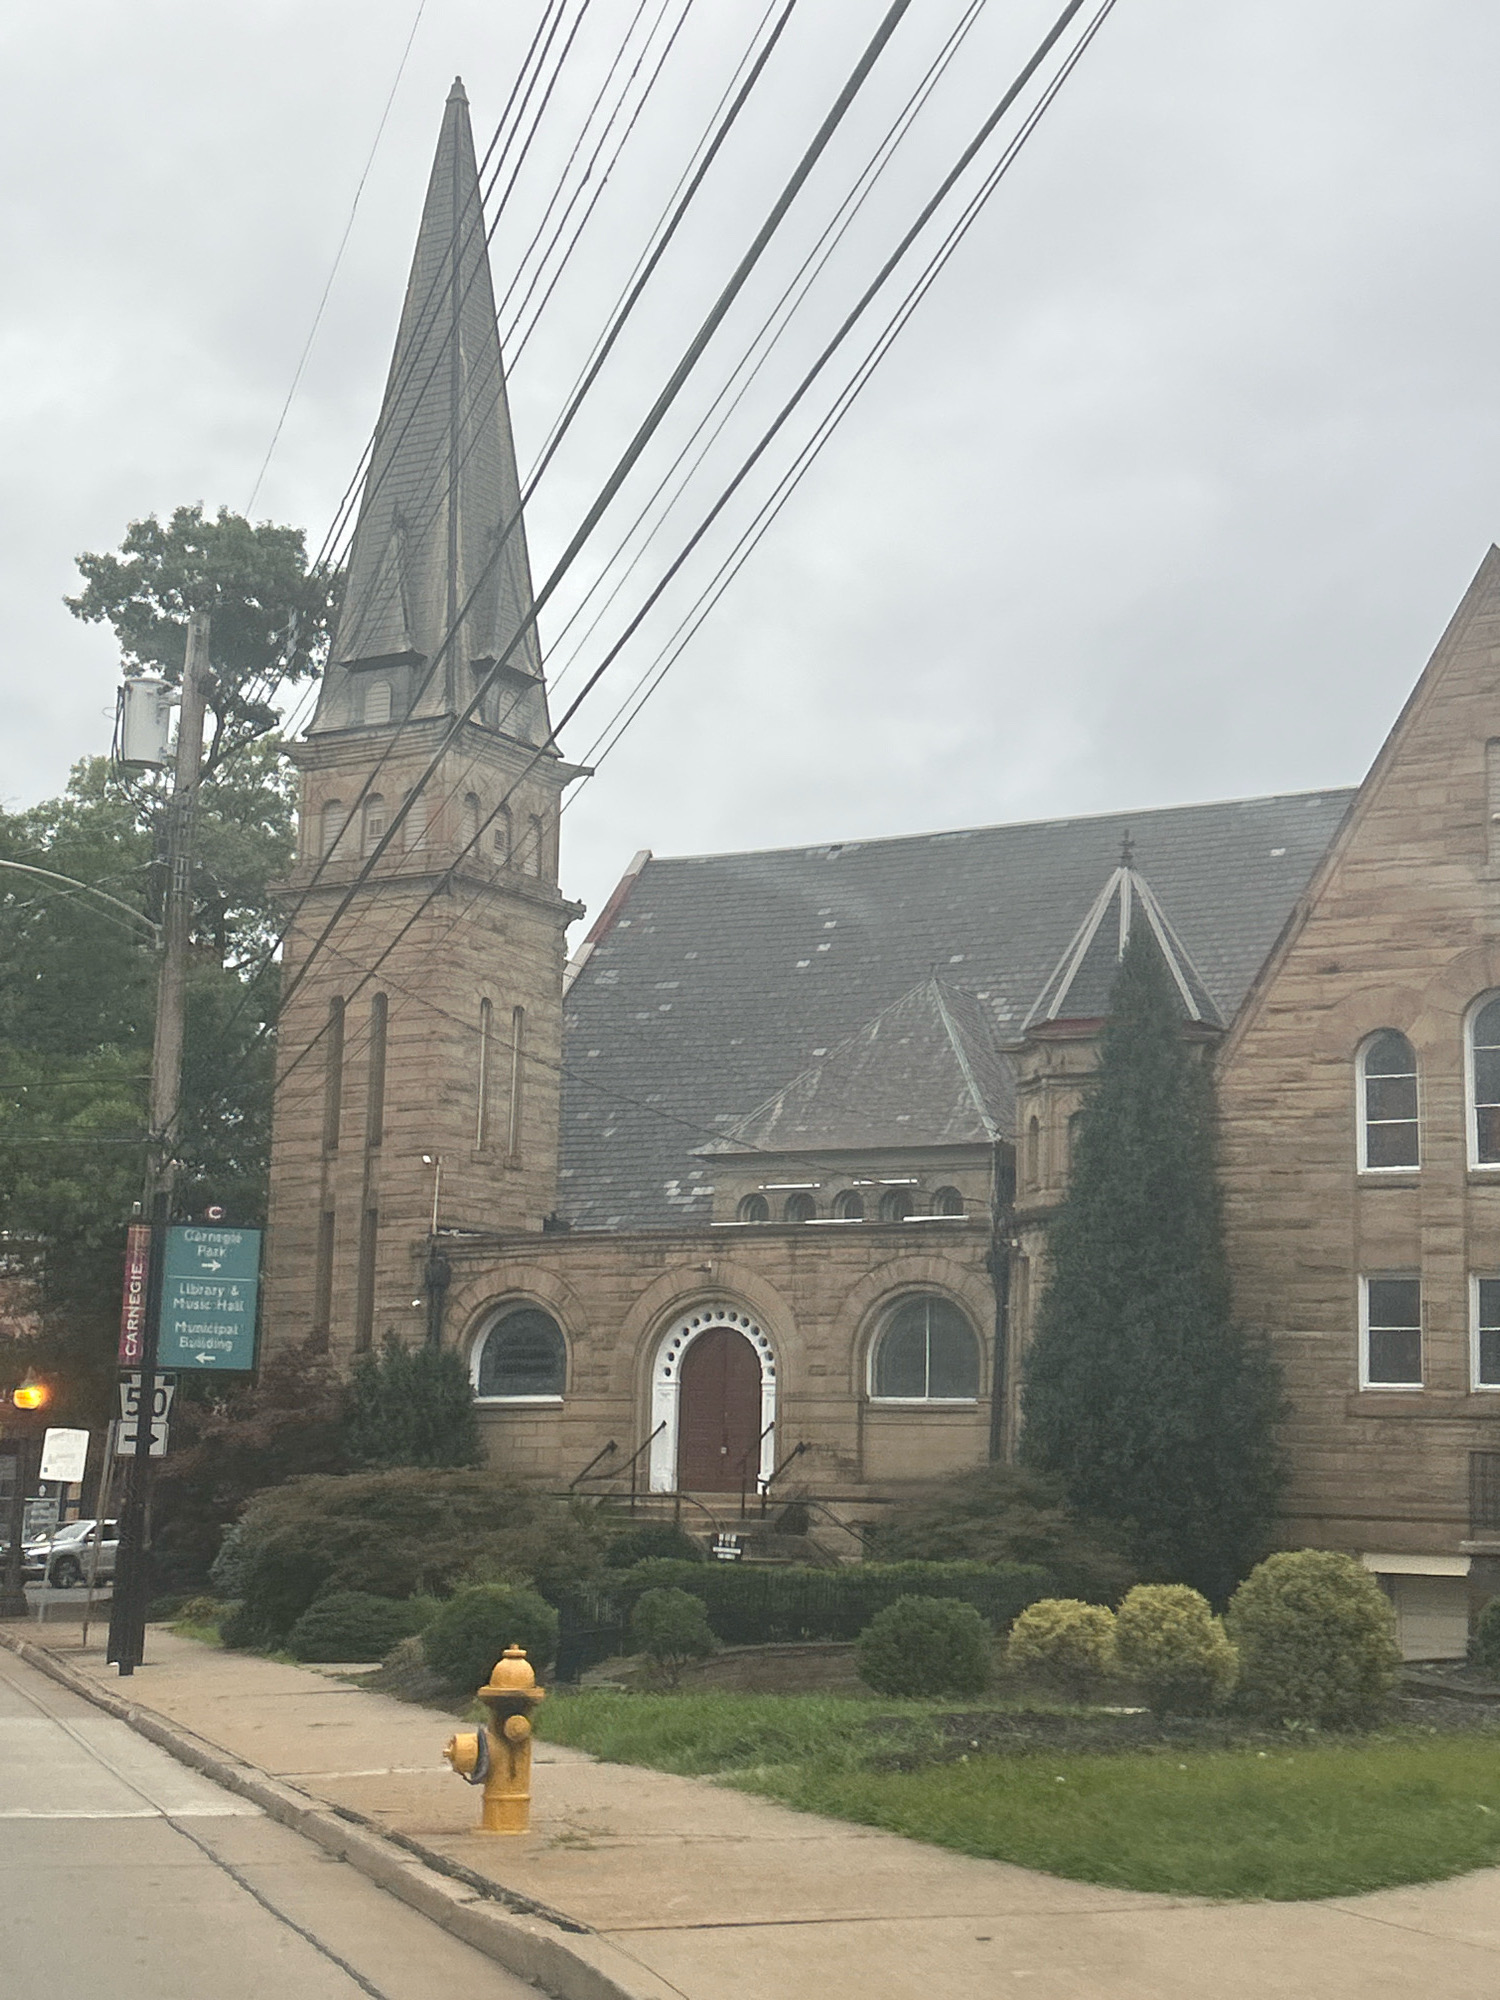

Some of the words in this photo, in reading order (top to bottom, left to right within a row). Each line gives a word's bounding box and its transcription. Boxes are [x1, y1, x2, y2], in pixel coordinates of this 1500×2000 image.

[184, 1229, 242, 1245] Carnegie
[197, 1245, 227, 1257] Park
[180, 1283, 225, 1297] Library
[231, 1285, 240, 1296] &
[125, 1262, 143, 1356] CARNEGIE
[173, 1298, 212, 1311] Music
[217, 1300, 244, 1312] Hall
[174, 1321, 239, 1336] Municipal
[179, 1336, 233, 1352] Building
[125, 1387, 168, 1418] 50
